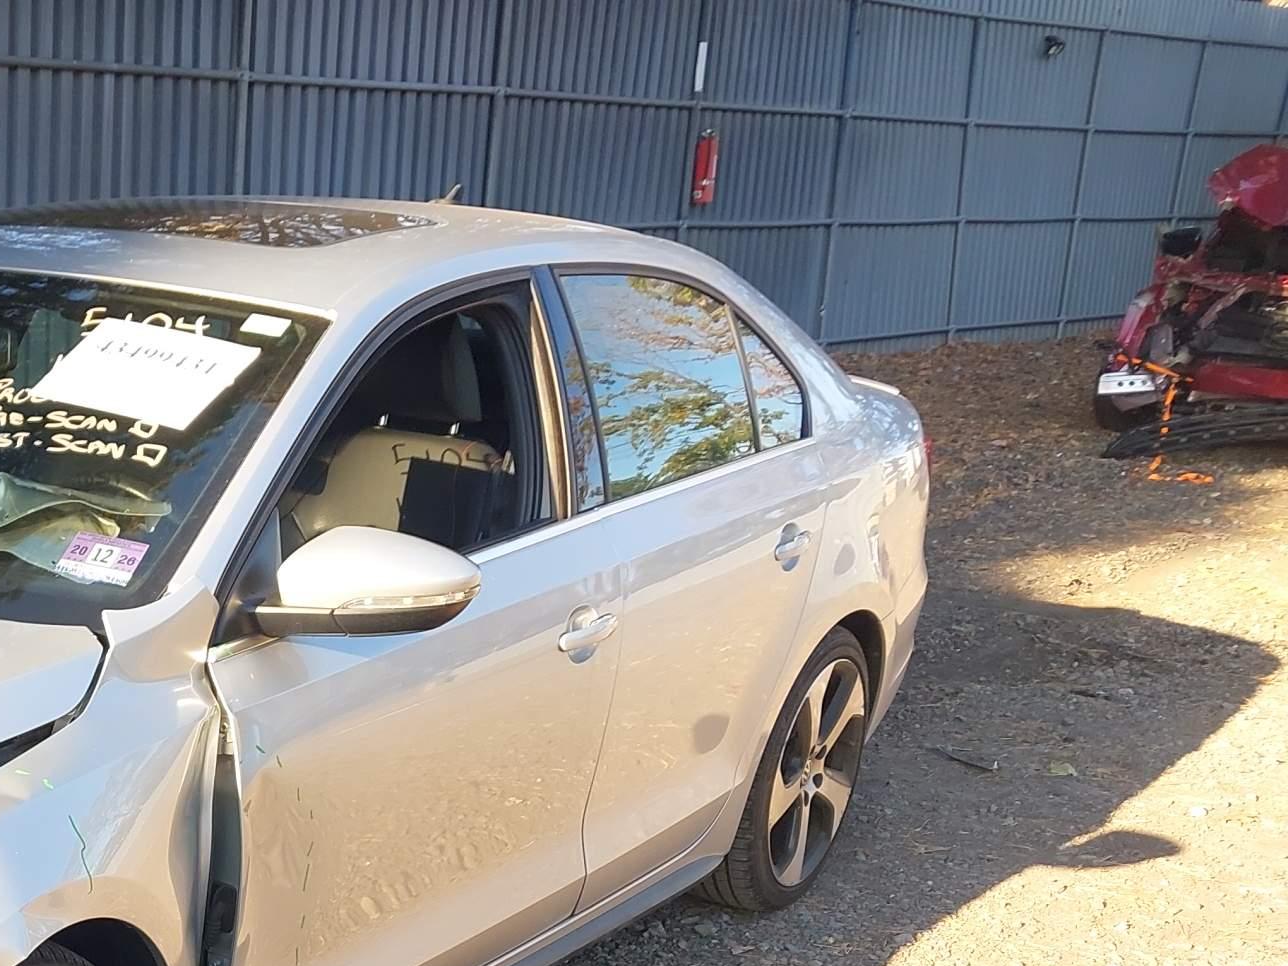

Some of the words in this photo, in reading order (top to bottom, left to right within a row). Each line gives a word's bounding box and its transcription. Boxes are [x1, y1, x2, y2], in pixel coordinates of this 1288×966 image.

[70, 544, 89, 556] 20
[91, 547, 114, 563] 12
[117, 554, 137, 566] 26
